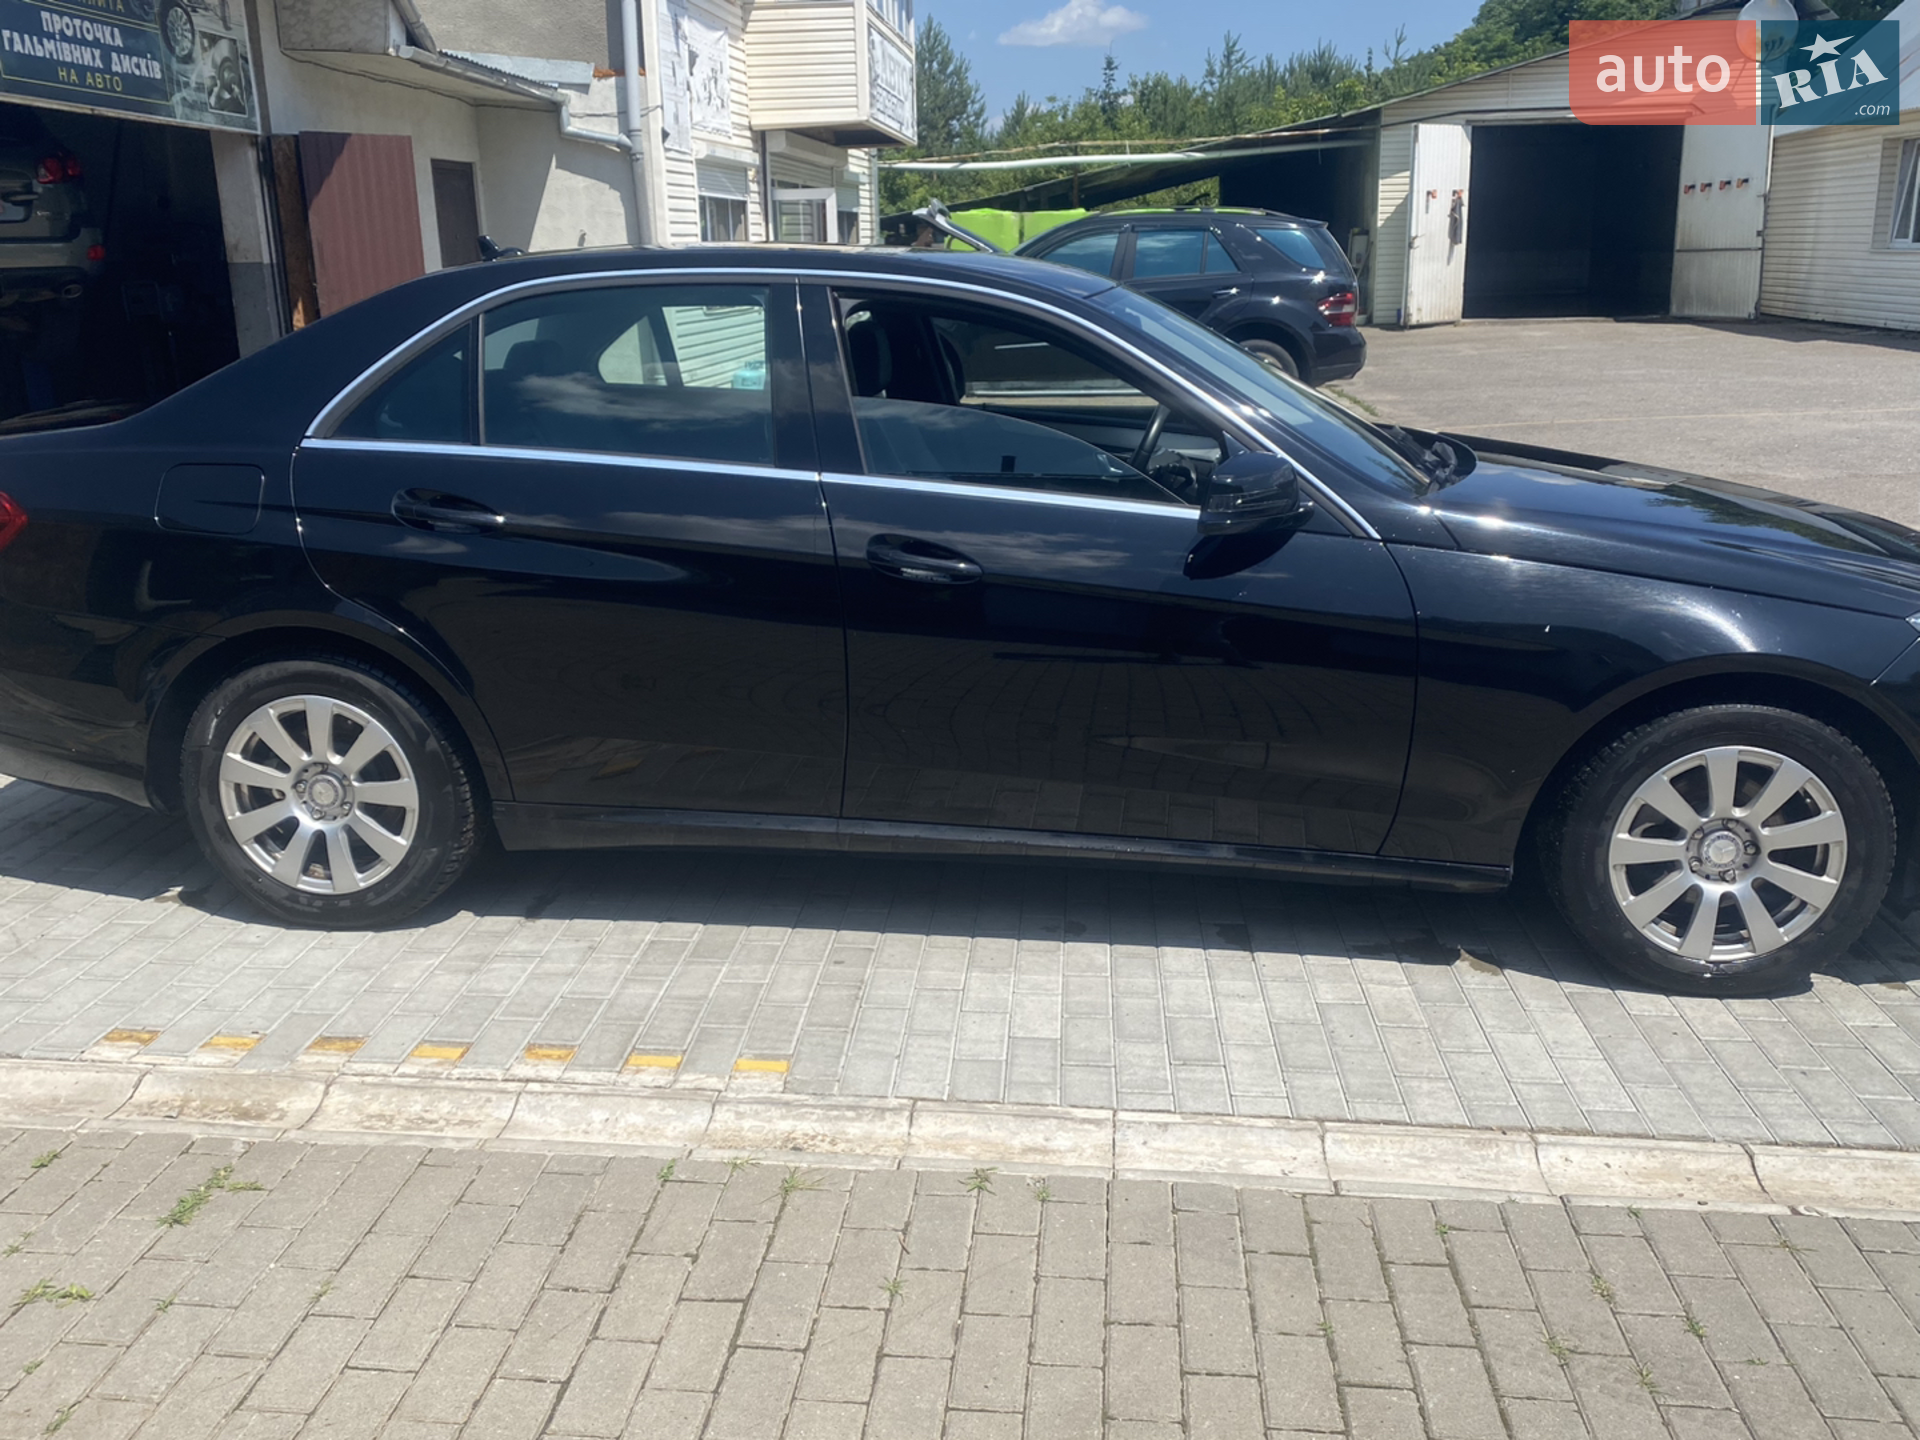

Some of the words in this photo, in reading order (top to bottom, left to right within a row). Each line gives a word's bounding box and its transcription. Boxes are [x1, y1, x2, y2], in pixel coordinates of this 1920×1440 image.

[40, 11, 124, 48] ПРОТОЧКА
[1, 29, 104, 69] ГАЛЬМІВНИХ
[111, 52, 162, 80] ДИСКІВ
[58, 66, 79, 84] НА
[86, 71, 123, 92] АВТО
